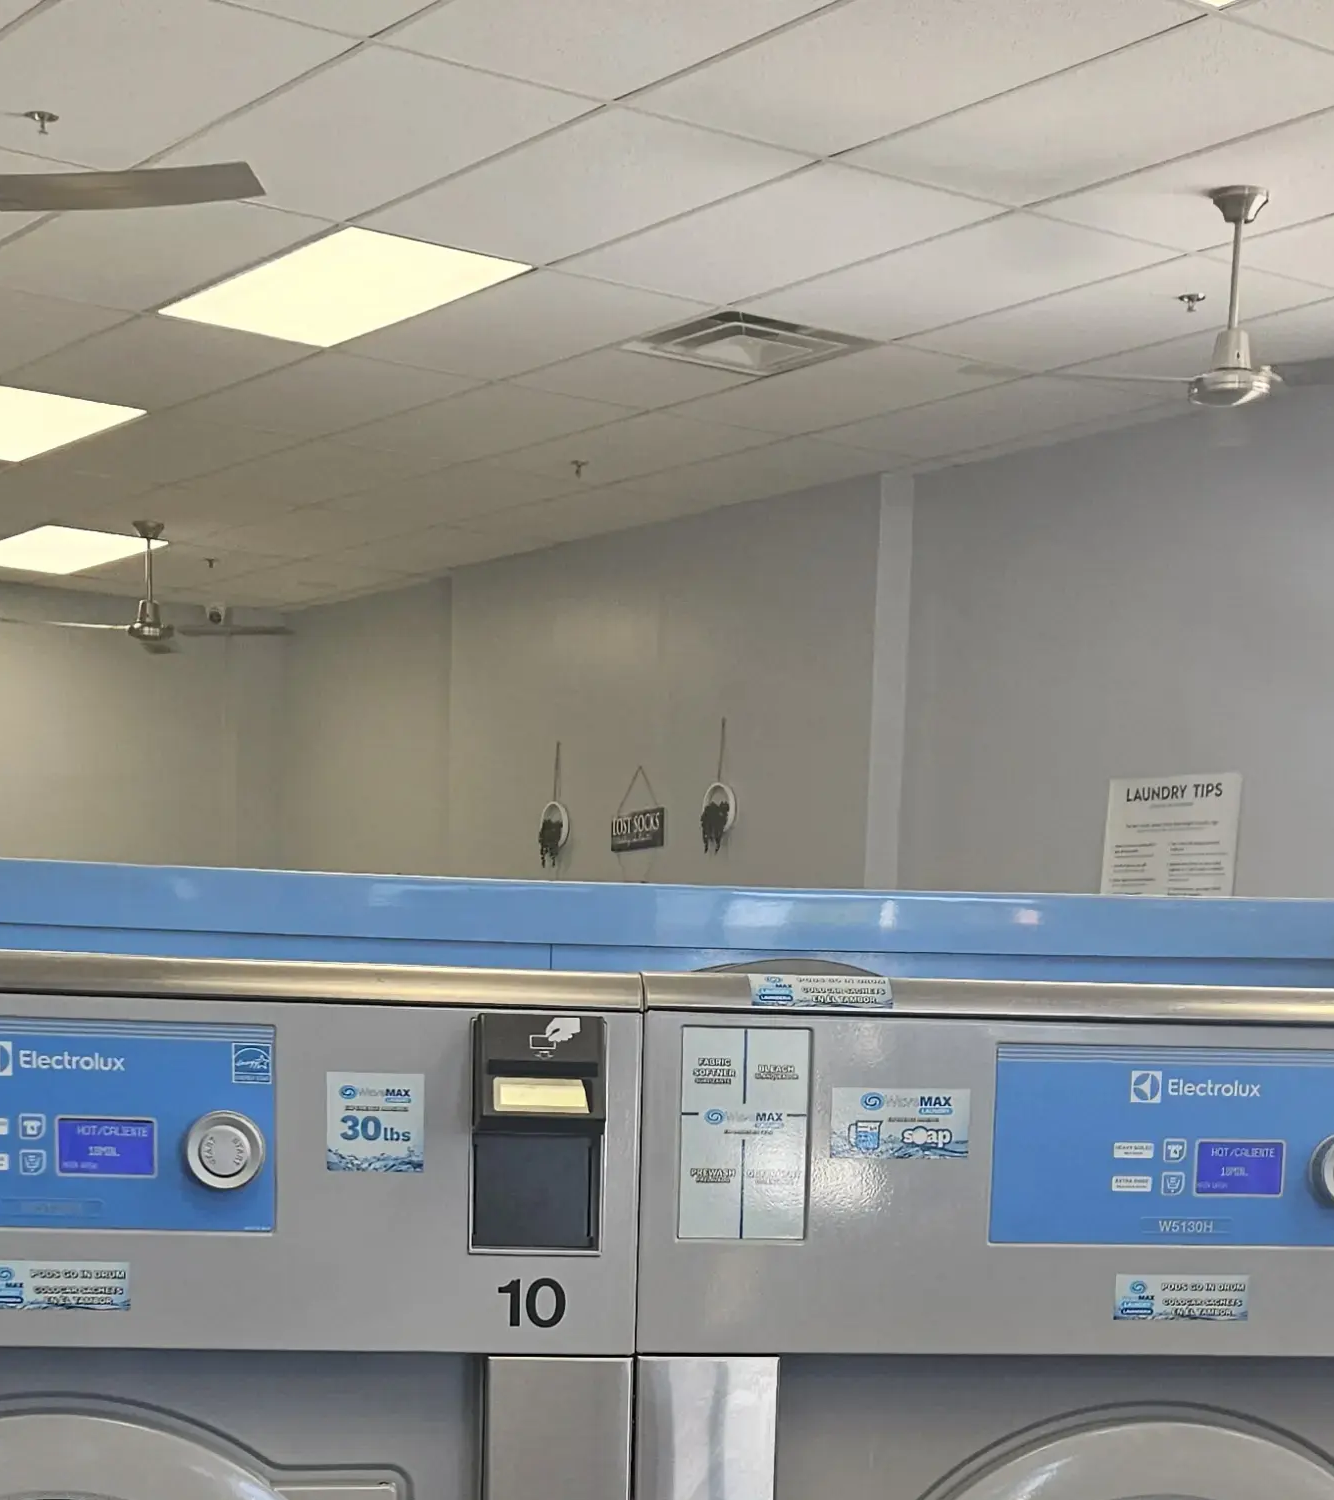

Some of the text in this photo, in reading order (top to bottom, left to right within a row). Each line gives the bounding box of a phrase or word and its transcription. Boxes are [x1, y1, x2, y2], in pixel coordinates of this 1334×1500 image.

[1126, 782, 1223, 803] LAUNDRY TIPS
[612, 811, 660, 836] LOST SOCKS
[19, 1050, 125, 1072] Electrolux
[698, 1057, 731, 1067] FABRIC
[693, 1068, 736, 1078] SOFTNER
[758, 1064, 795, 1073] BLEACH
[1167, 1078, 1261, 1097] Electrolux
[76, 1124, 149, 1138] HOT/CALIENTE
[339, 1115, 412, 1142] 30lbs
[902, 1126, 953, 1148] soap
[1211, 1147, 1276, 1158] HOT/CALIENTE
[690, 1168, 736, 1178] PREWASH
[1158, 1220, 1214, 1233] W5130H
[30, 1269, 126, 1280] PODS GO IN DRUM
[1161, 1283, 1246, 1292] PODS GO IN DRUM
[497, 1277, 567, 1328] 10
